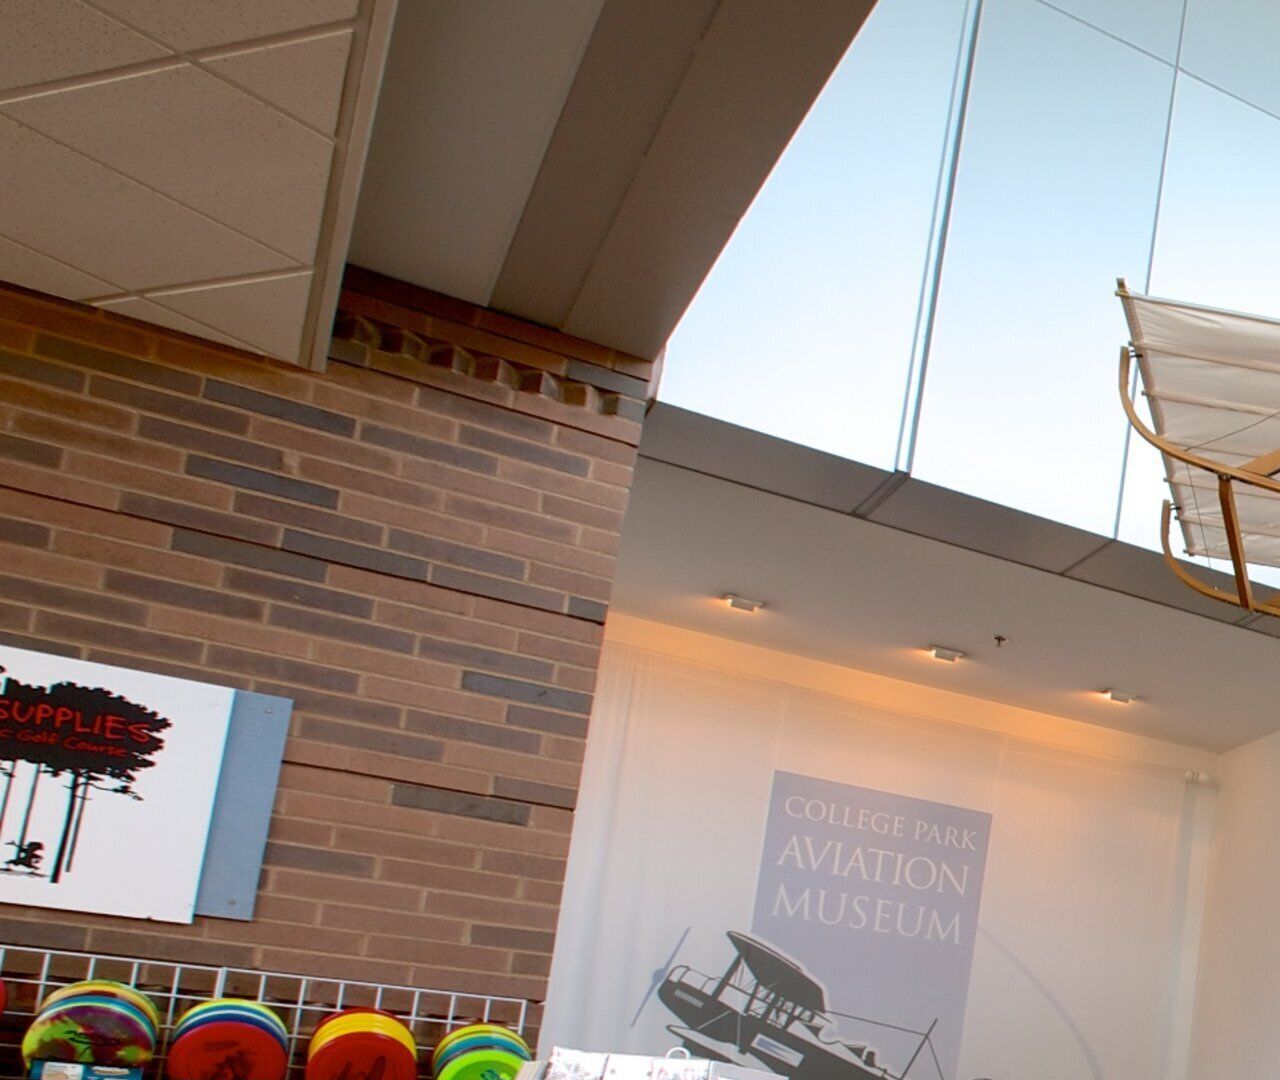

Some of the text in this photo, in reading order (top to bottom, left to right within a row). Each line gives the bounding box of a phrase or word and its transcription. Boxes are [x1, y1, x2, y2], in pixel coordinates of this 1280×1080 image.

[0, 699, 151, 743] SUPPLIES
[16, 730, 59, 745] Golf
[63, 736, 127, 757] Course
[784, 795, 978, 852] COLLEGE PARK
[775, 833, 970, 897] AVIATION
[771, 883, 962, 945] MUSEUM
